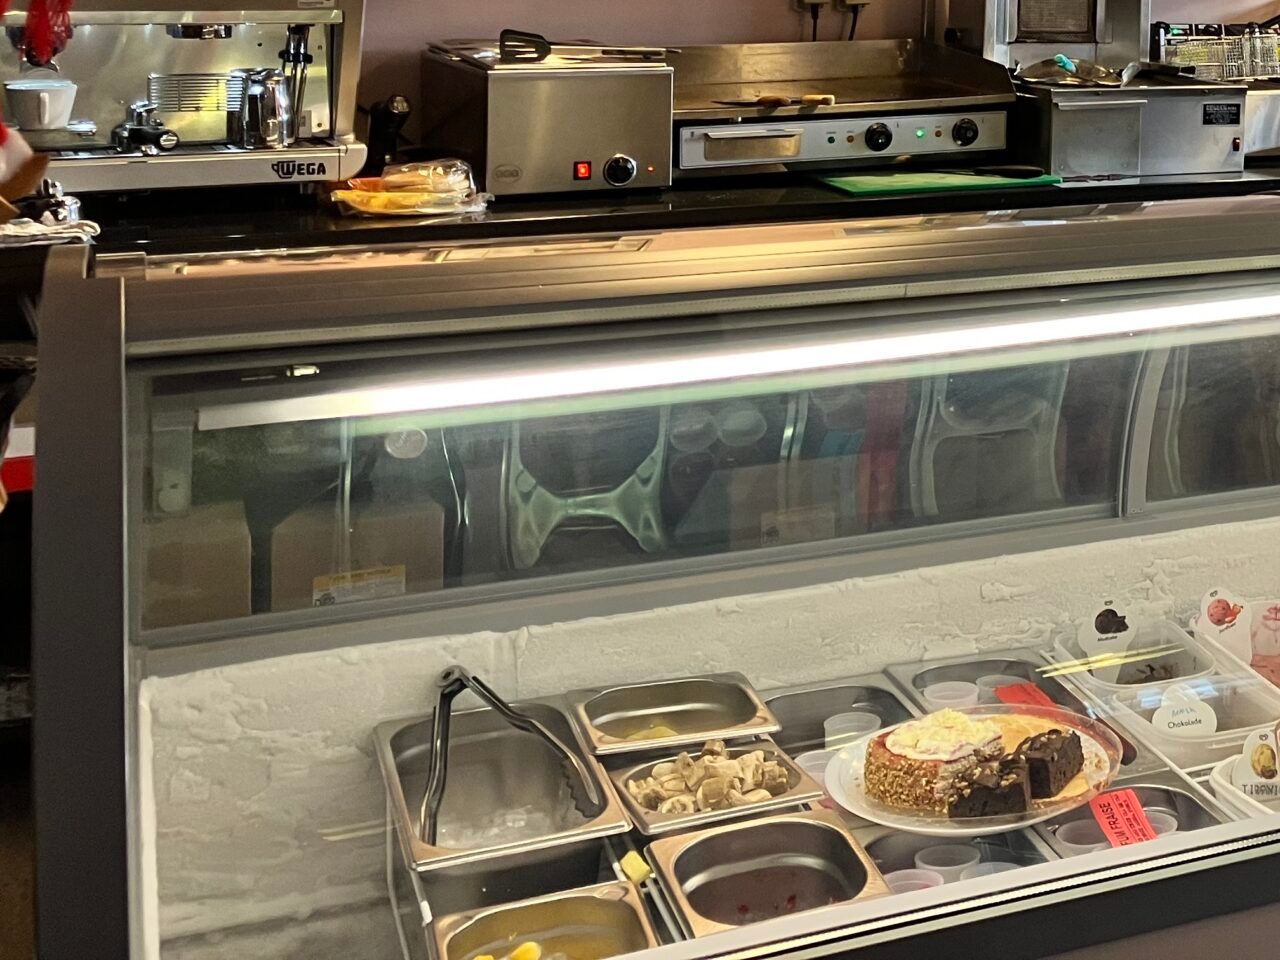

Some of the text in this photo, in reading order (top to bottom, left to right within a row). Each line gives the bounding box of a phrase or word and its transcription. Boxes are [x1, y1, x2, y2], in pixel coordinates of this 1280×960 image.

[271, 160, 326, 179] WEGA
[1168, 718, 1202, 729] Chokolade
[1098, 801, 1122, 830] FRAISE
